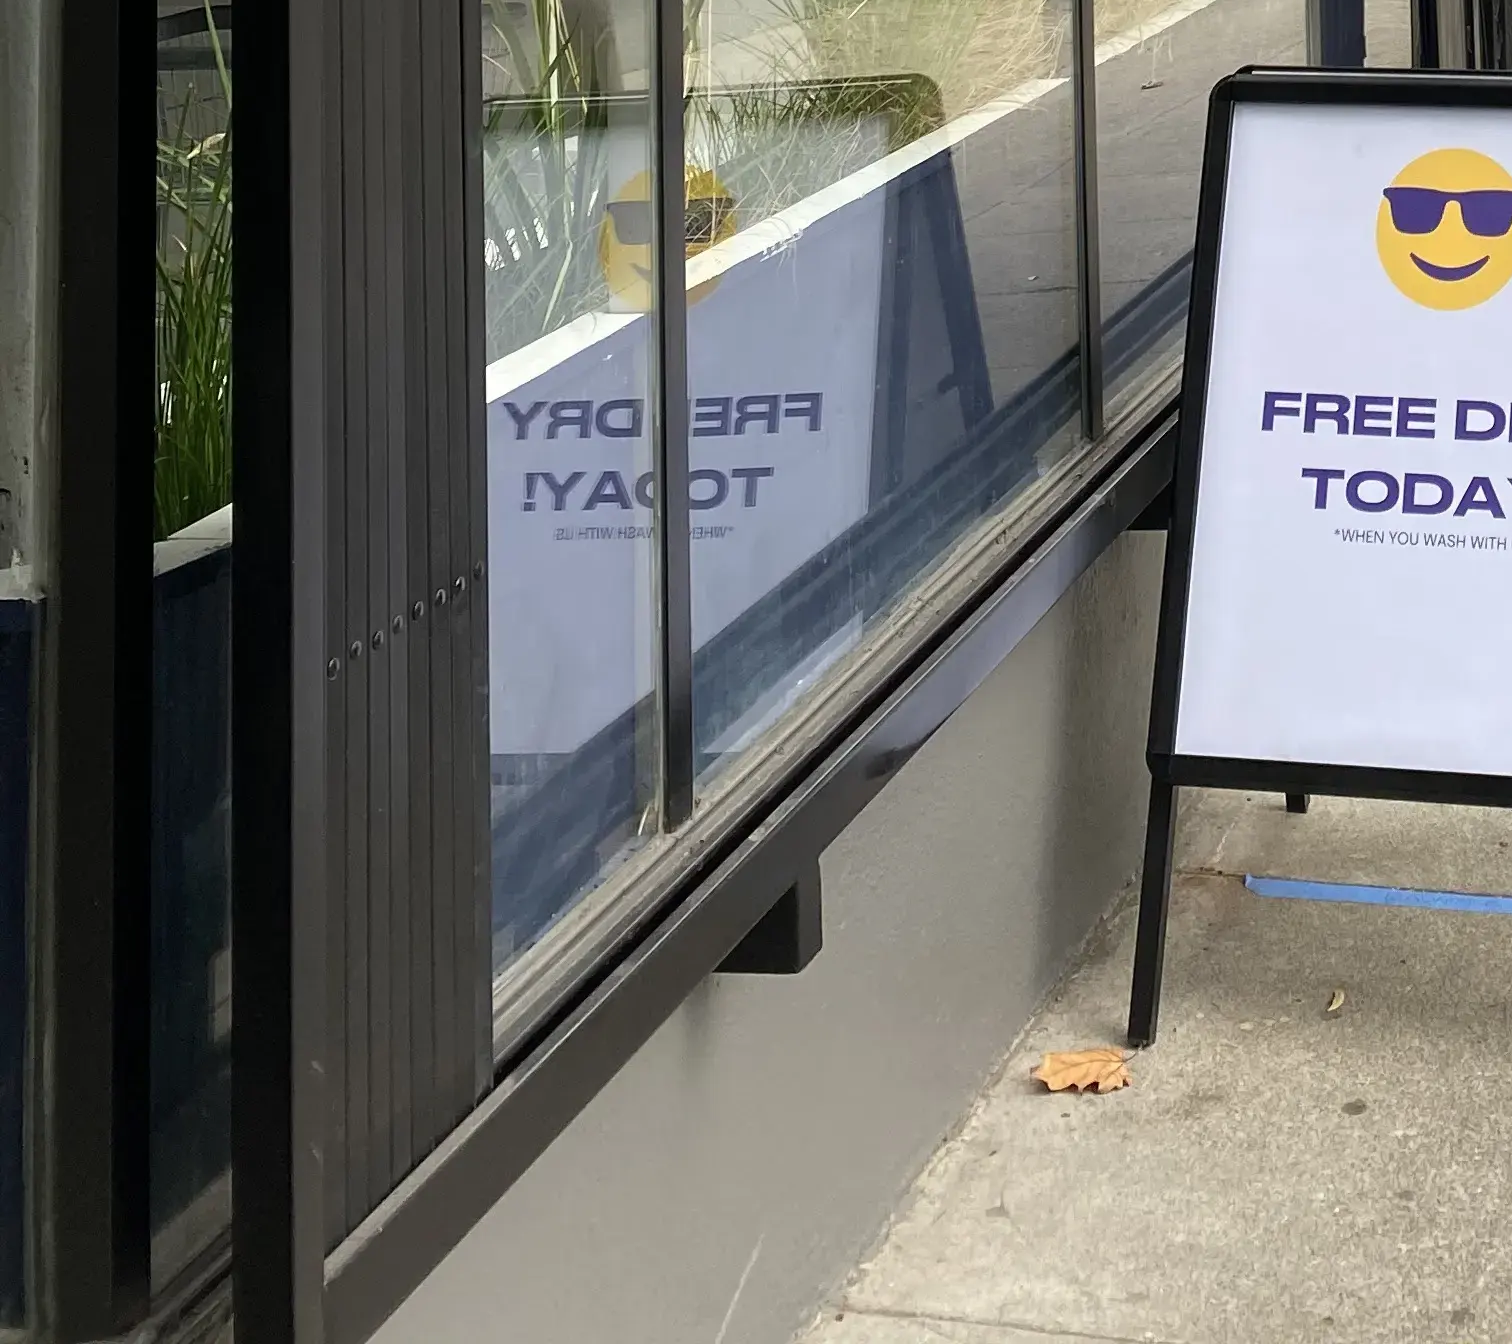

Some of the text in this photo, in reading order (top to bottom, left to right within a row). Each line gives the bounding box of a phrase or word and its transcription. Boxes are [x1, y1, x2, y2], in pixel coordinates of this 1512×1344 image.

[1261, 391, 1438, 439] FREE
[1389, 530, 1419, 546] YOU
[1423, 532, 1466, 549] WASH
[1470, 535, 1507, 551] WITH
